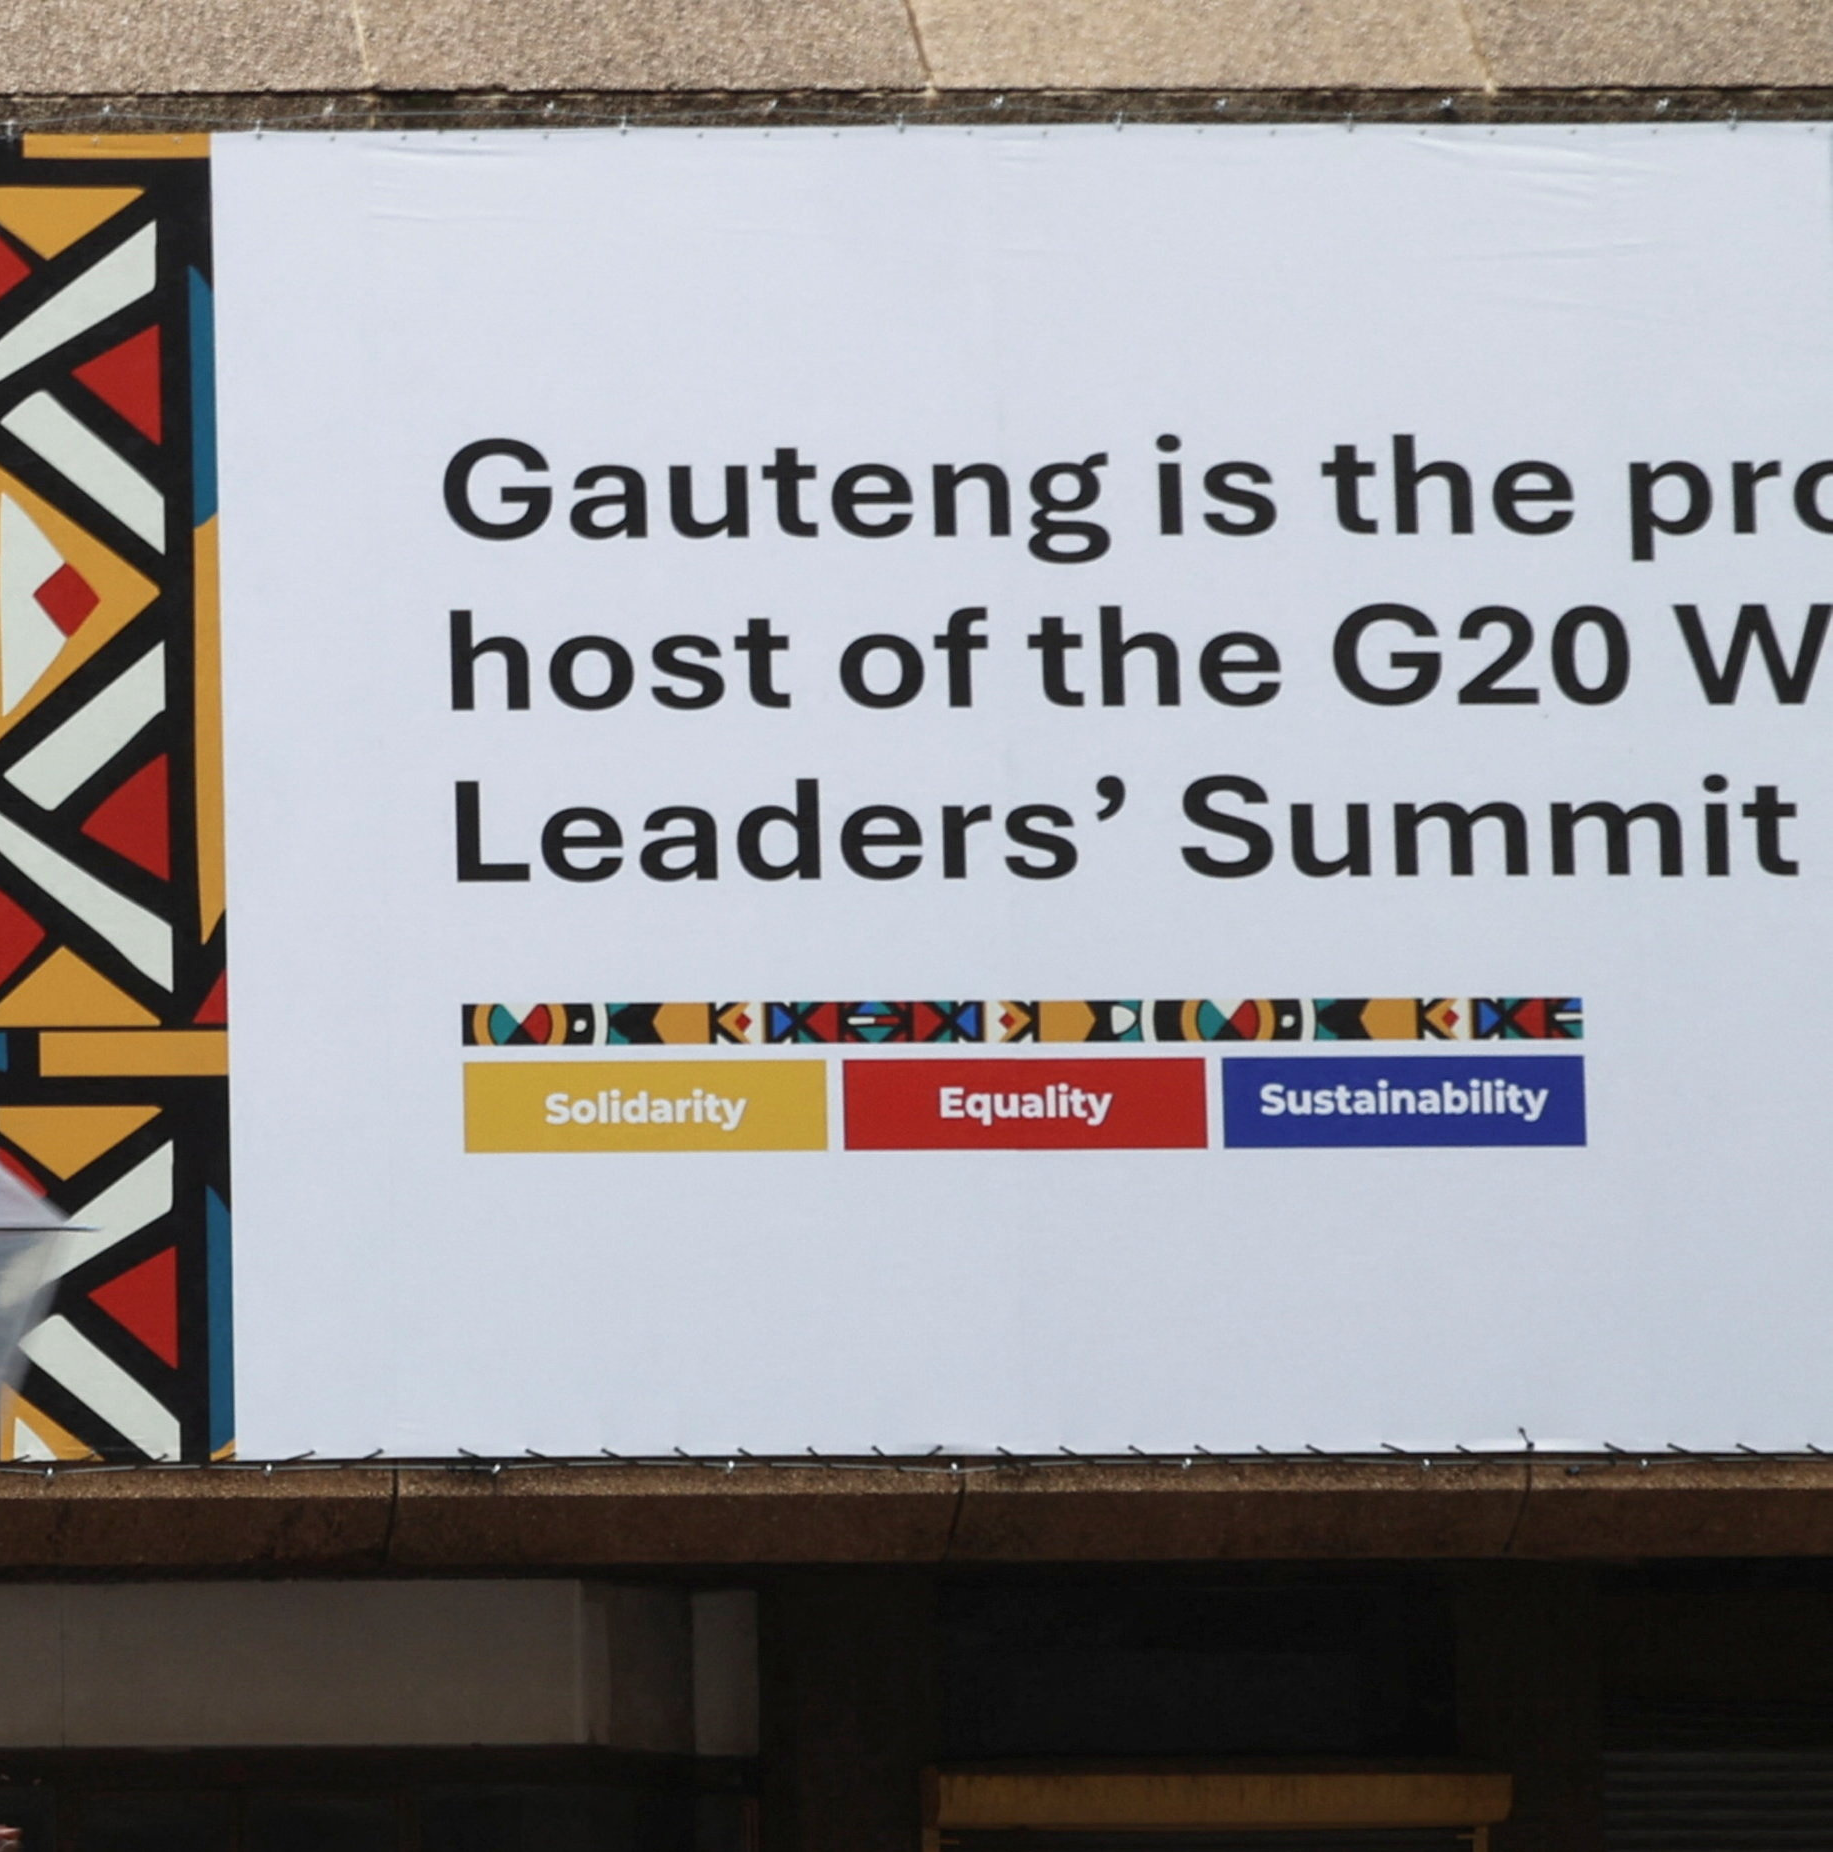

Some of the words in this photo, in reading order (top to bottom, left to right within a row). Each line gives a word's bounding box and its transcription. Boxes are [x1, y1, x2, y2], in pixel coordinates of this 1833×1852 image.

[444, 439, 1110, 563] Gauteng
[1157, 435, 1276, 535] is
[1322, 435, 1573, 534] the
[451, 611, 790, 710] host
[840, 607, 987, 708] of
[1028, 606, 1280, 706] the
[1334, 604, 1629, 705] G20
[456, 776, 1125, 882] Leaders’
[1182, 775, 1798, 878] Summit
[545, 1088, 747, 1131] Solidarity
[941, 1083, 1112, 1125] Equality
[1261, 1079, 1548, 1121] Sustainability
